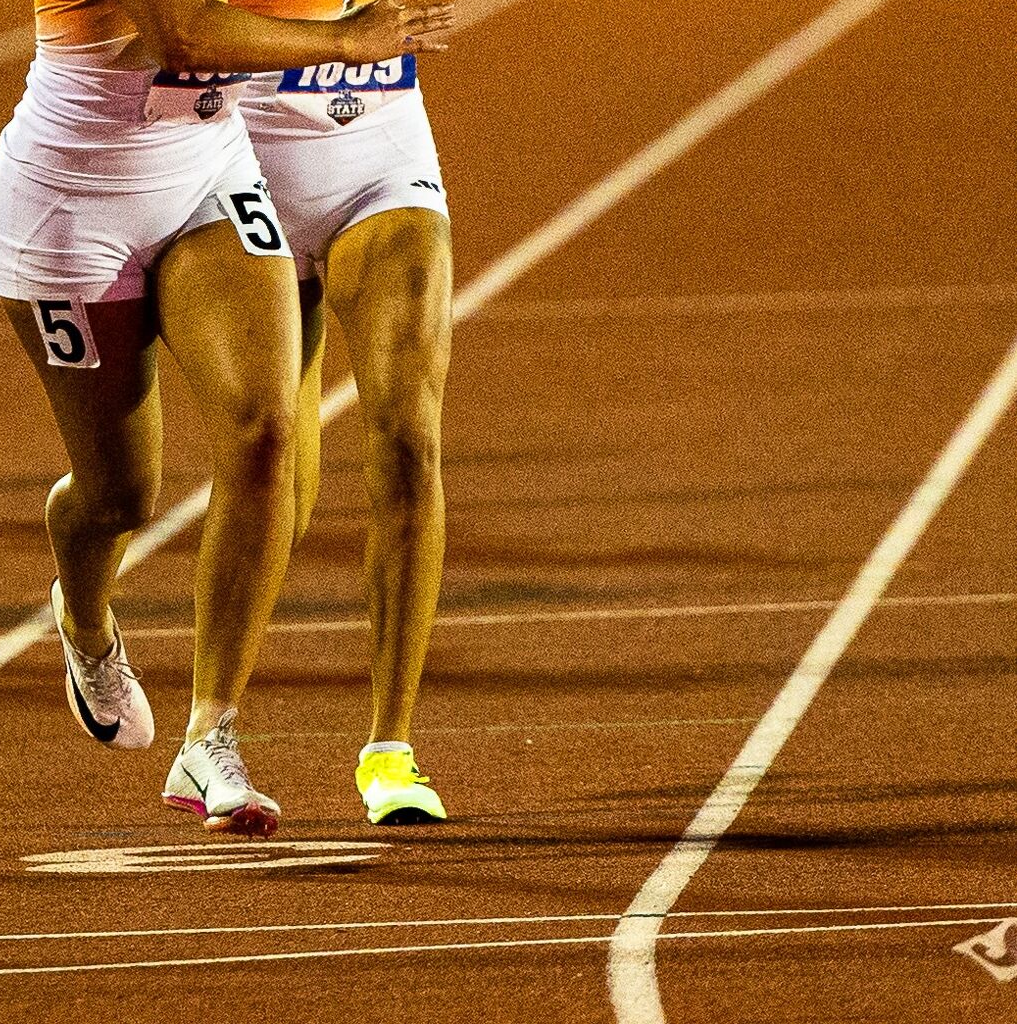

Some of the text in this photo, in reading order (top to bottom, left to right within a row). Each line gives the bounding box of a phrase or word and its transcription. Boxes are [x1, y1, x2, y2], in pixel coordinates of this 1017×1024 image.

[195, 98, 223, 109] STATE
[327, 103, 365, 115] STATE
[229, 192, 282, 250] 5
[36, 299, 87, 363] 5
